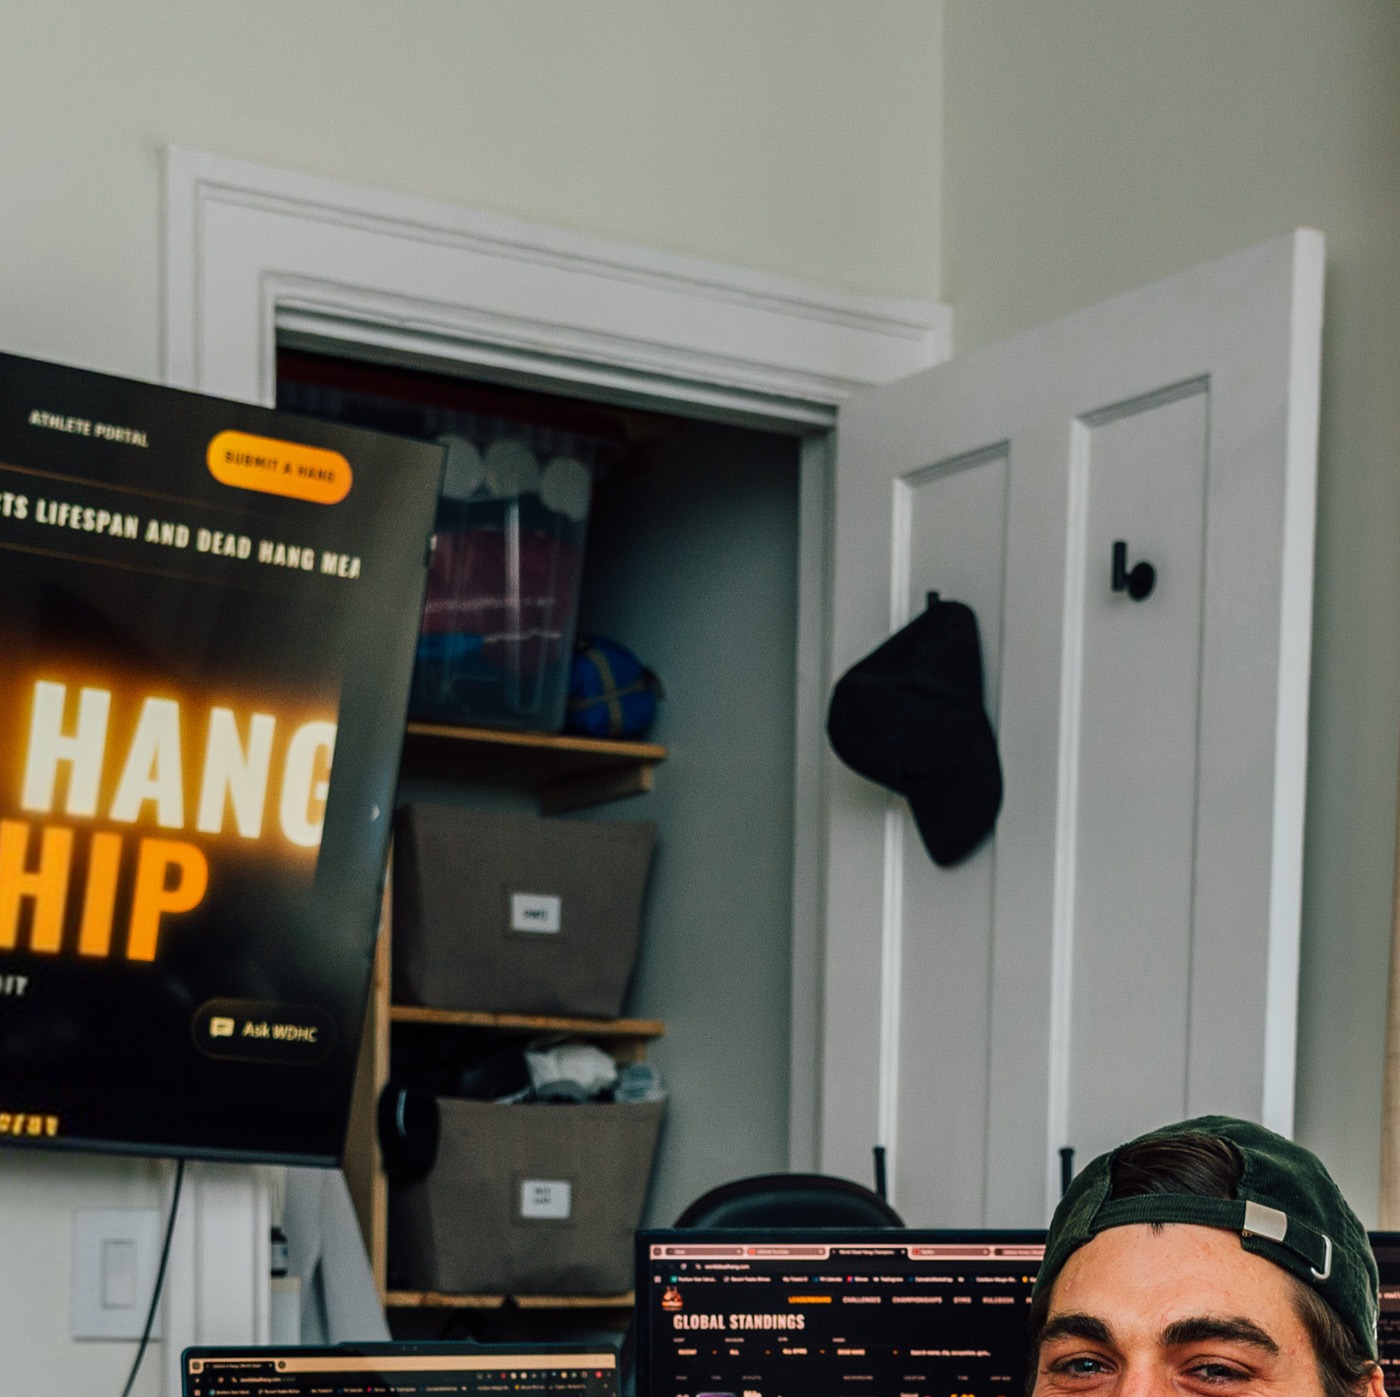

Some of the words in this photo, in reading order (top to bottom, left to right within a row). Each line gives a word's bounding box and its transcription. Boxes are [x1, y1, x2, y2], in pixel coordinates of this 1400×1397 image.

[29, 408, 89, 438] ATHLETE
[92, 420, 150, 449] PORTAL
[35, 498, 140, 542] LIFESPAN
[146, 519, 190, 552] AND
[197, 528, 252, 563] DEAD
[258, 540, 316, 572] HANG
[241, 1020, 271, 1042] Ask
[673, 1313, 727, 1331] GLOBAL
[729, 1313, 806, 1331] STANDINGS
